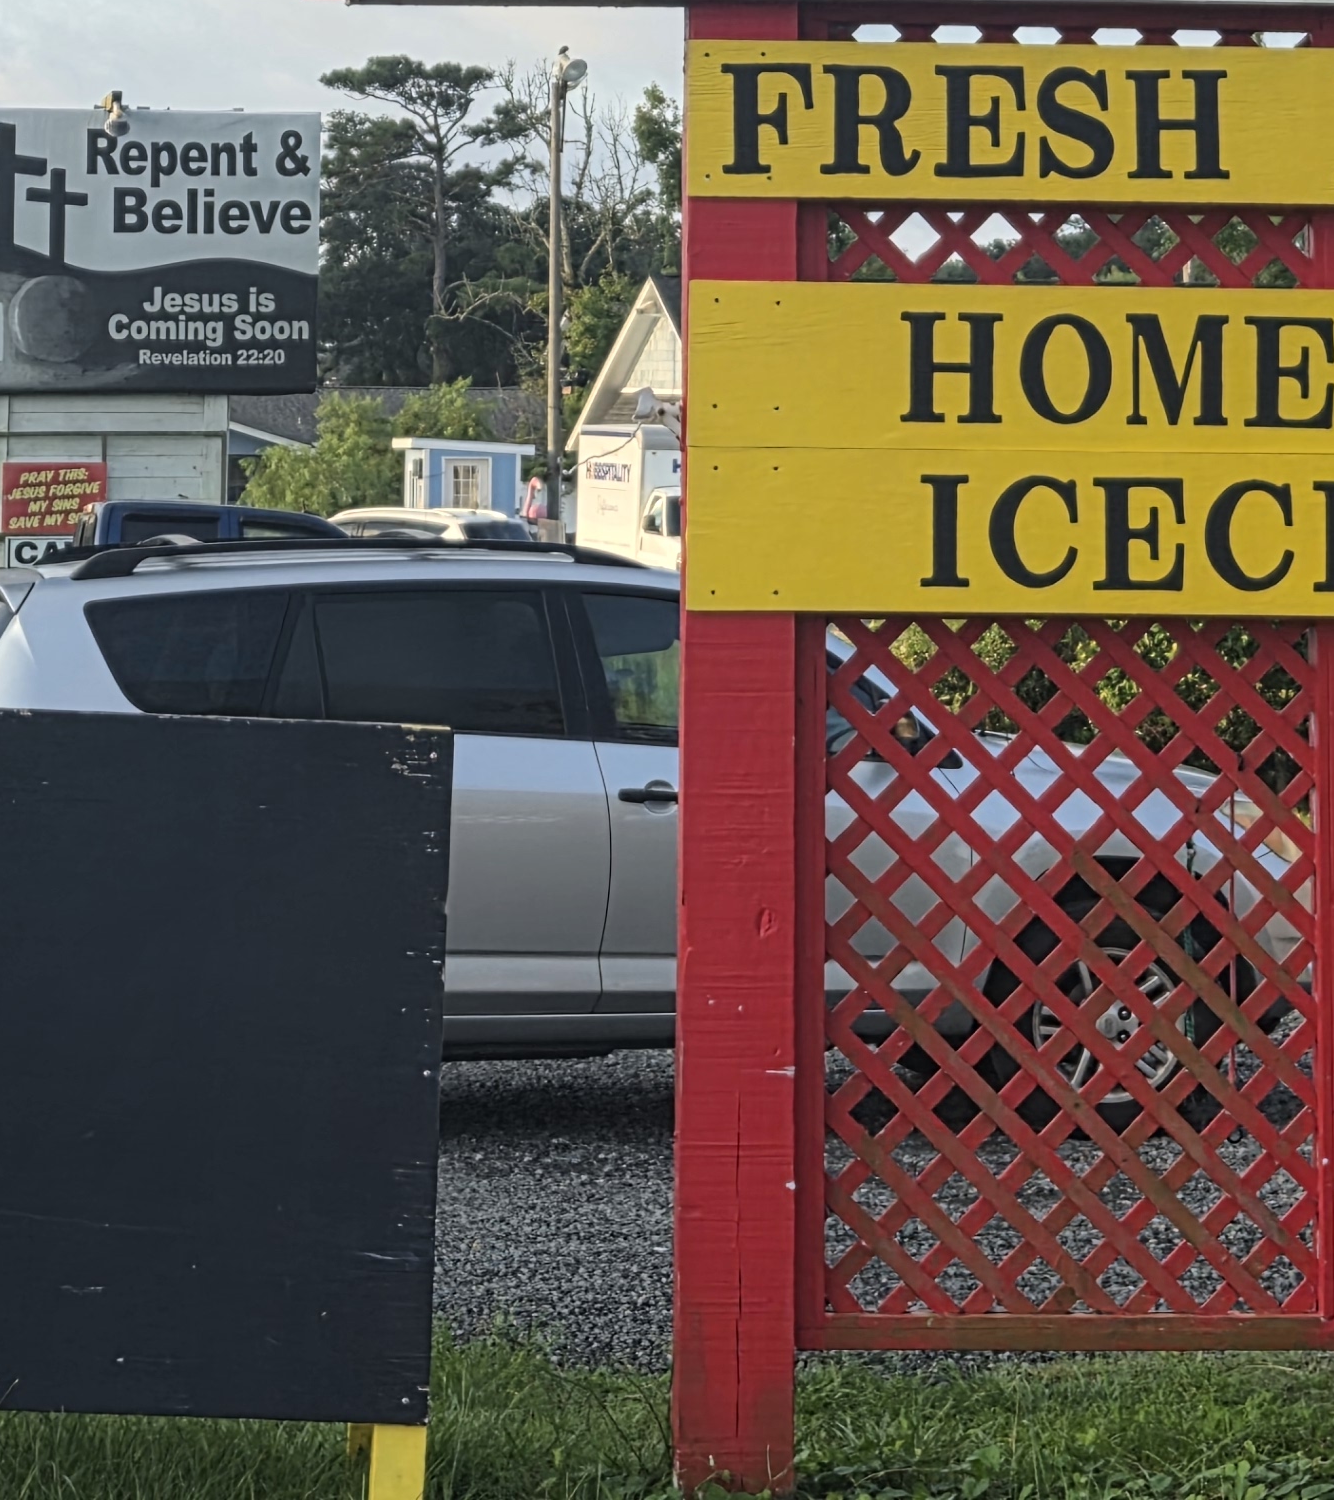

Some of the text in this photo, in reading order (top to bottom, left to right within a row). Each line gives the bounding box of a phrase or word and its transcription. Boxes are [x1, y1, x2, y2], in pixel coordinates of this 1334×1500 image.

[720, 62, 1231, 180] FRESH
[86, 128, 312, 188] Repent &
[112, 186, 313, 235] Believe
[142, 286, 276, 314] Jesus is
[107, 313, 310, 347] Coming Soon
[138, 348, 286, 366] Revelation 22:20
[19, 468, 89, 485] PRAY THIS:
[7, 481, 102, 500] JESUS FORGIVE
[28, 498, 80, 513] MY SINS
[8, 515, 42, 529] SAVE
[43, 514, 65, 526] MY
